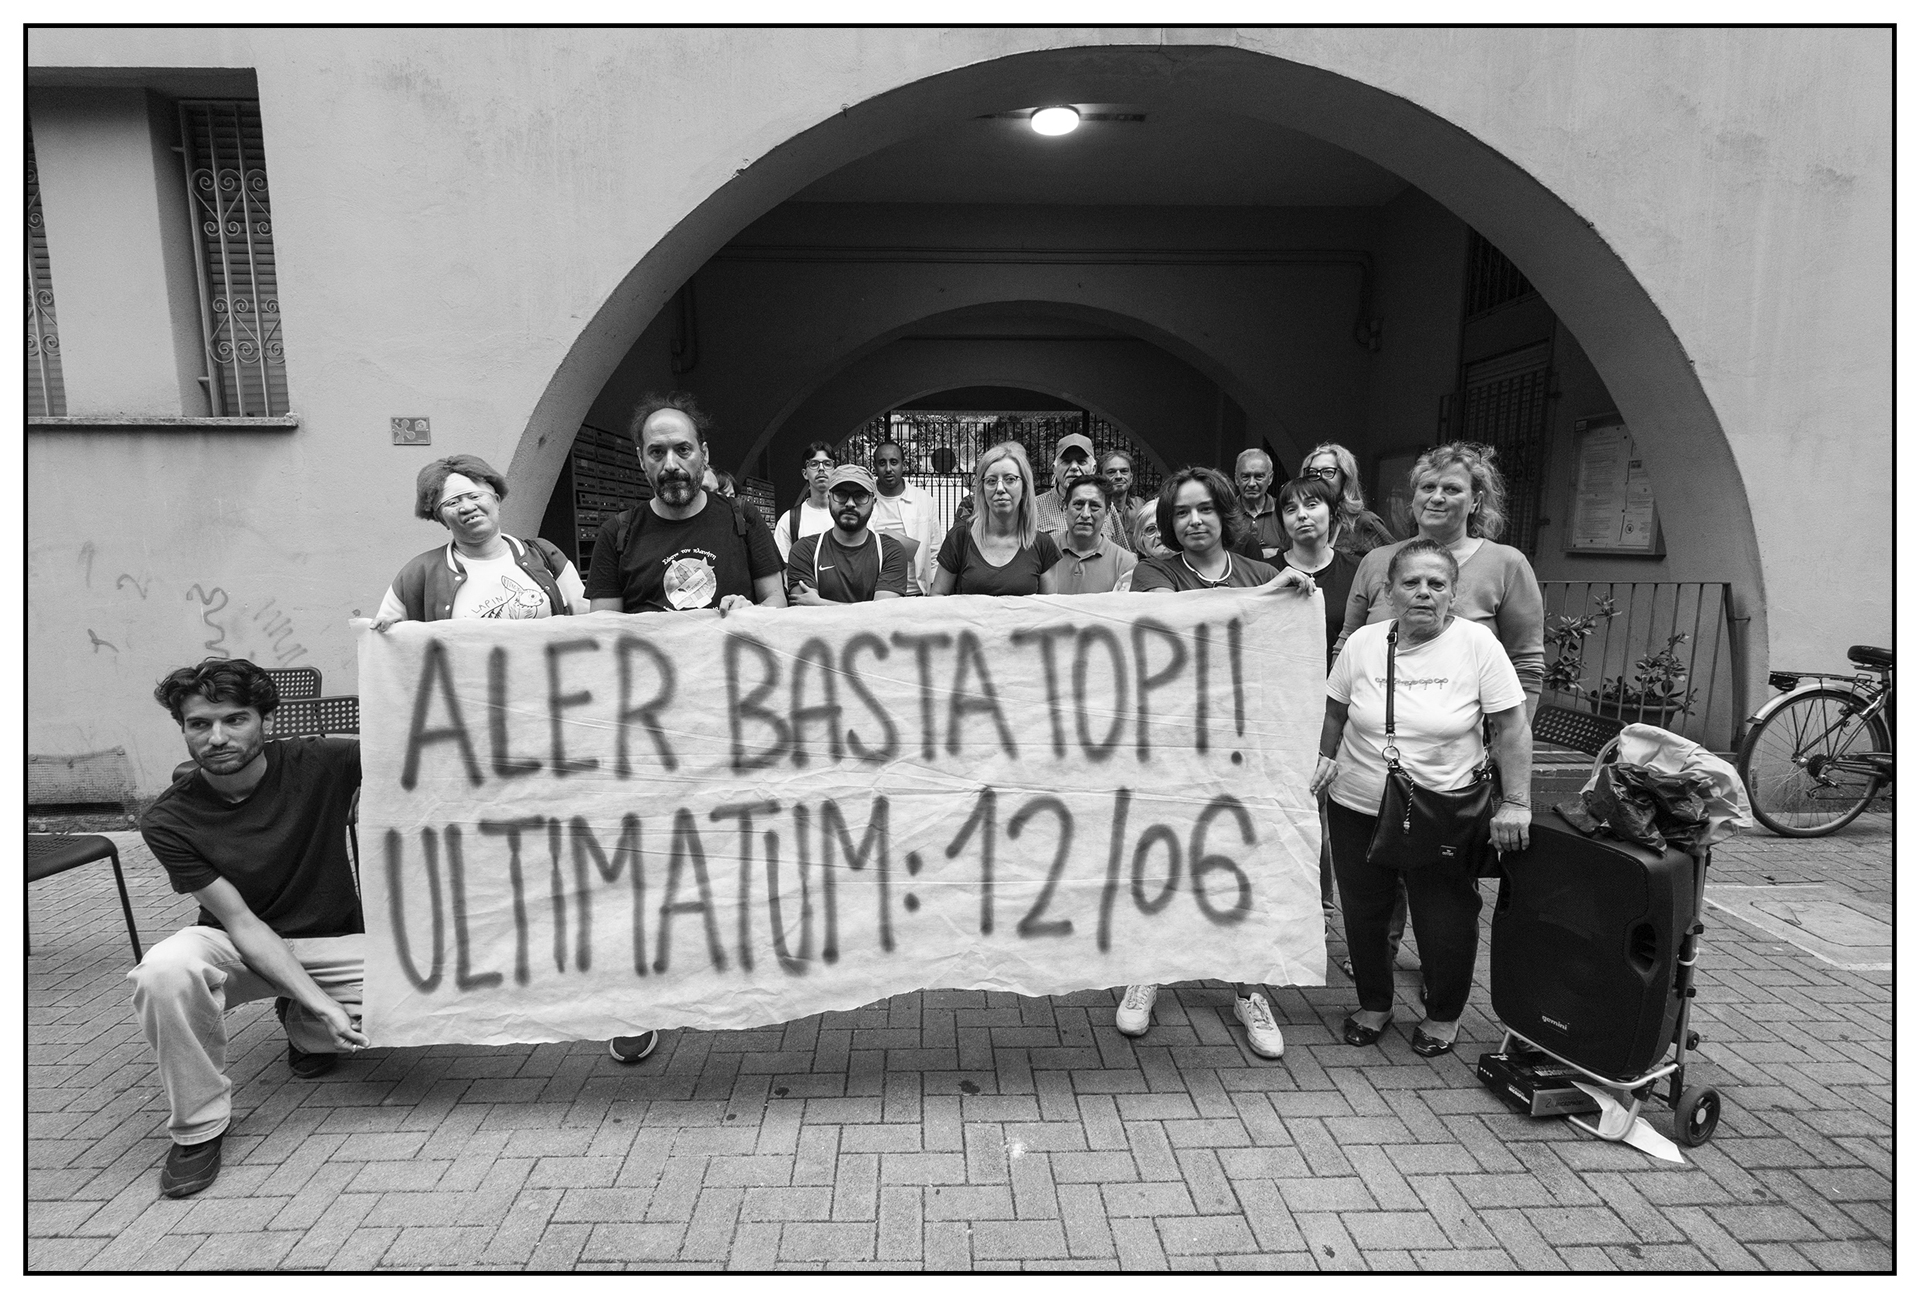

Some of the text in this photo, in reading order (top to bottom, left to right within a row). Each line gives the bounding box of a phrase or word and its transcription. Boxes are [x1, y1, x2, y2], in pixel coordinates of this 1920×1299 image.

[471, 596, 503, 613] LAPIN
[400, 634, 678, 791] ALER
[722, 630, 1018, 776] BASTA
[384, 785, 1257, 994] ULTIMATUM: 12/06
[1541, 1015, 1568, 1031] gemini
